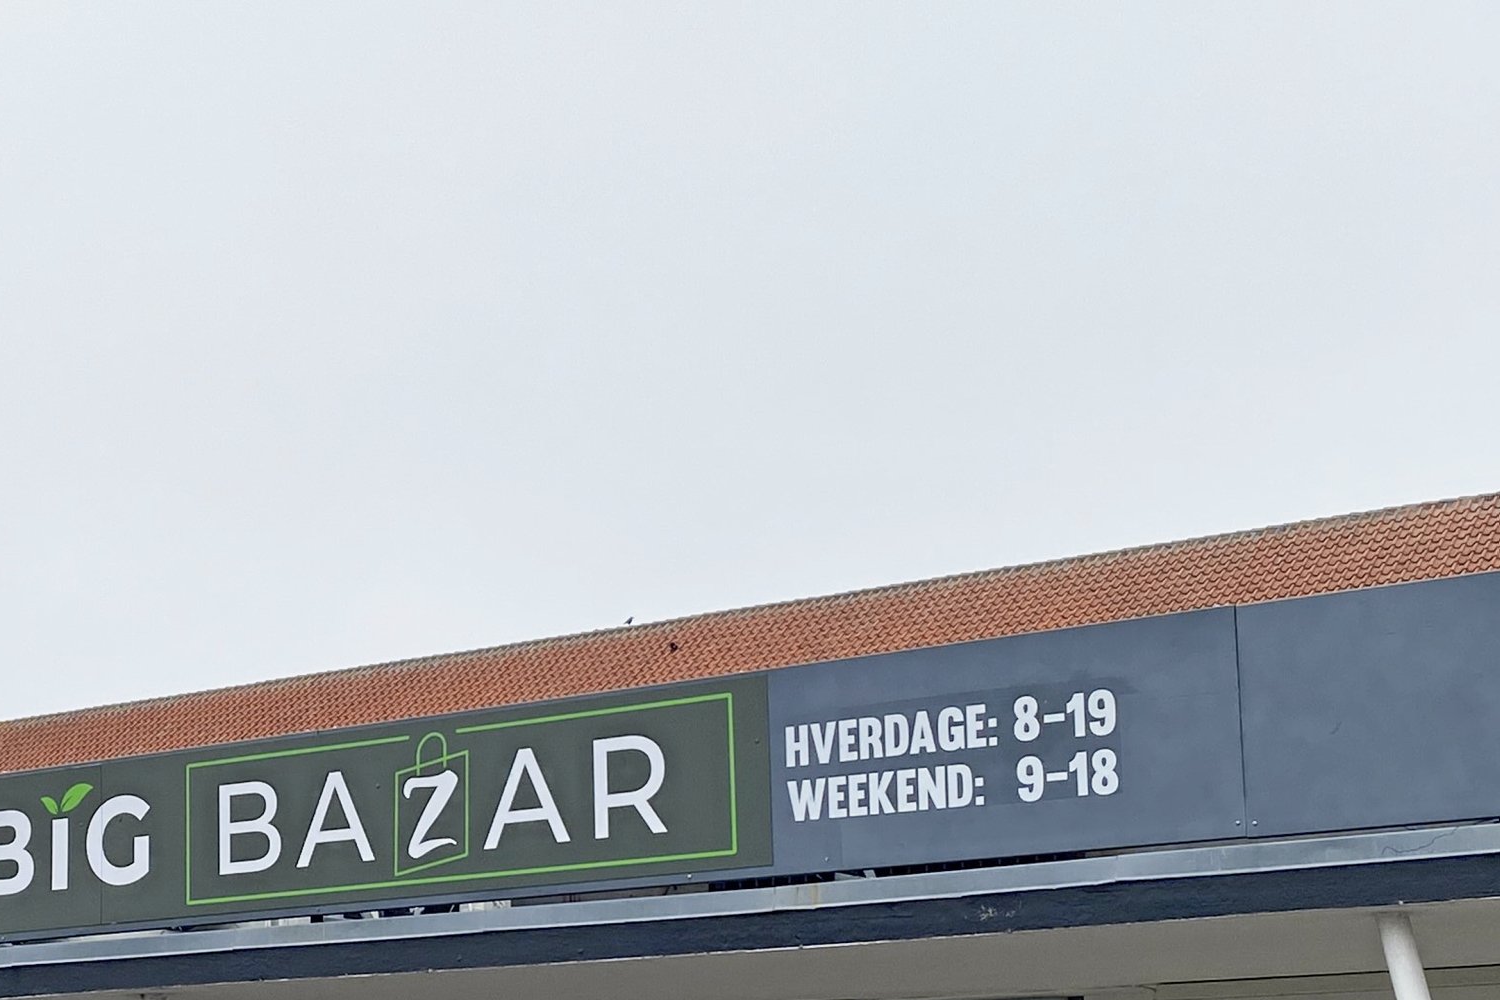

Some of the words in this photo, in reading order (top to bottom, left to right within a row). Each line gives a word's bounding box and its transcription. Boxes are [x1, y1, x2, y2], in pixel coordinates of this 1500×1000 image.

[784, 702, 999, 768] HVERDAGE:
[1012, 688, 1118, 743] 8-19
[786, 763, 986, 822] WEEKEND:
[1015, 747, 1120, 803] 9-18
